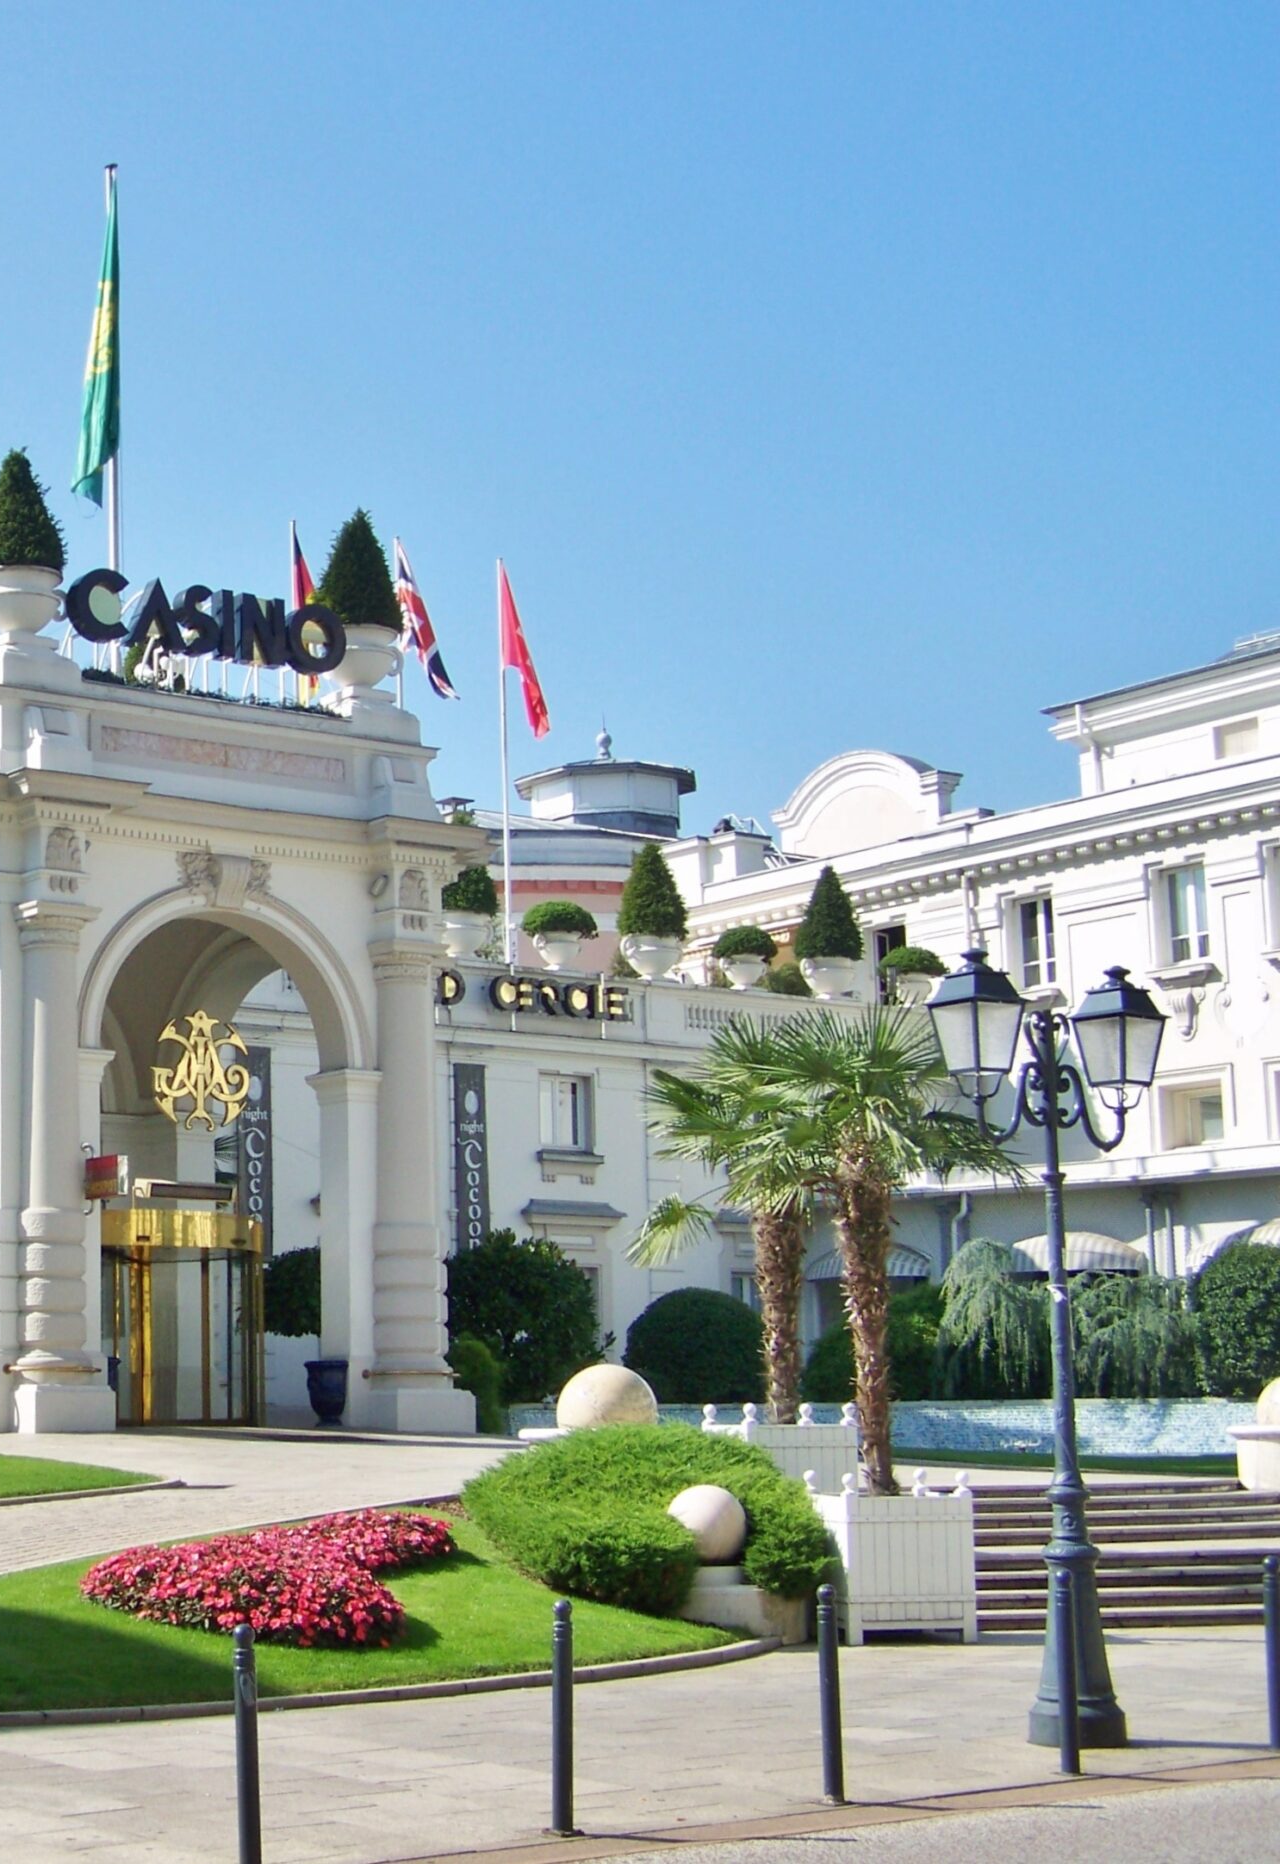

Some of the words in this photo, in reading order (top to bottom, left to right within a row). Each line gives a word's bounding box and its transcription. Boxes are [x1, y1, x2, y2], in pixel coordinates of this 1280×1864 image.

[66, 568, 346, 675] CASINO
[489, 974, 632, 1022] CERCLE
[459, 1120, 484, 1135] night
[238, 1125, 266, 1223] Coco
